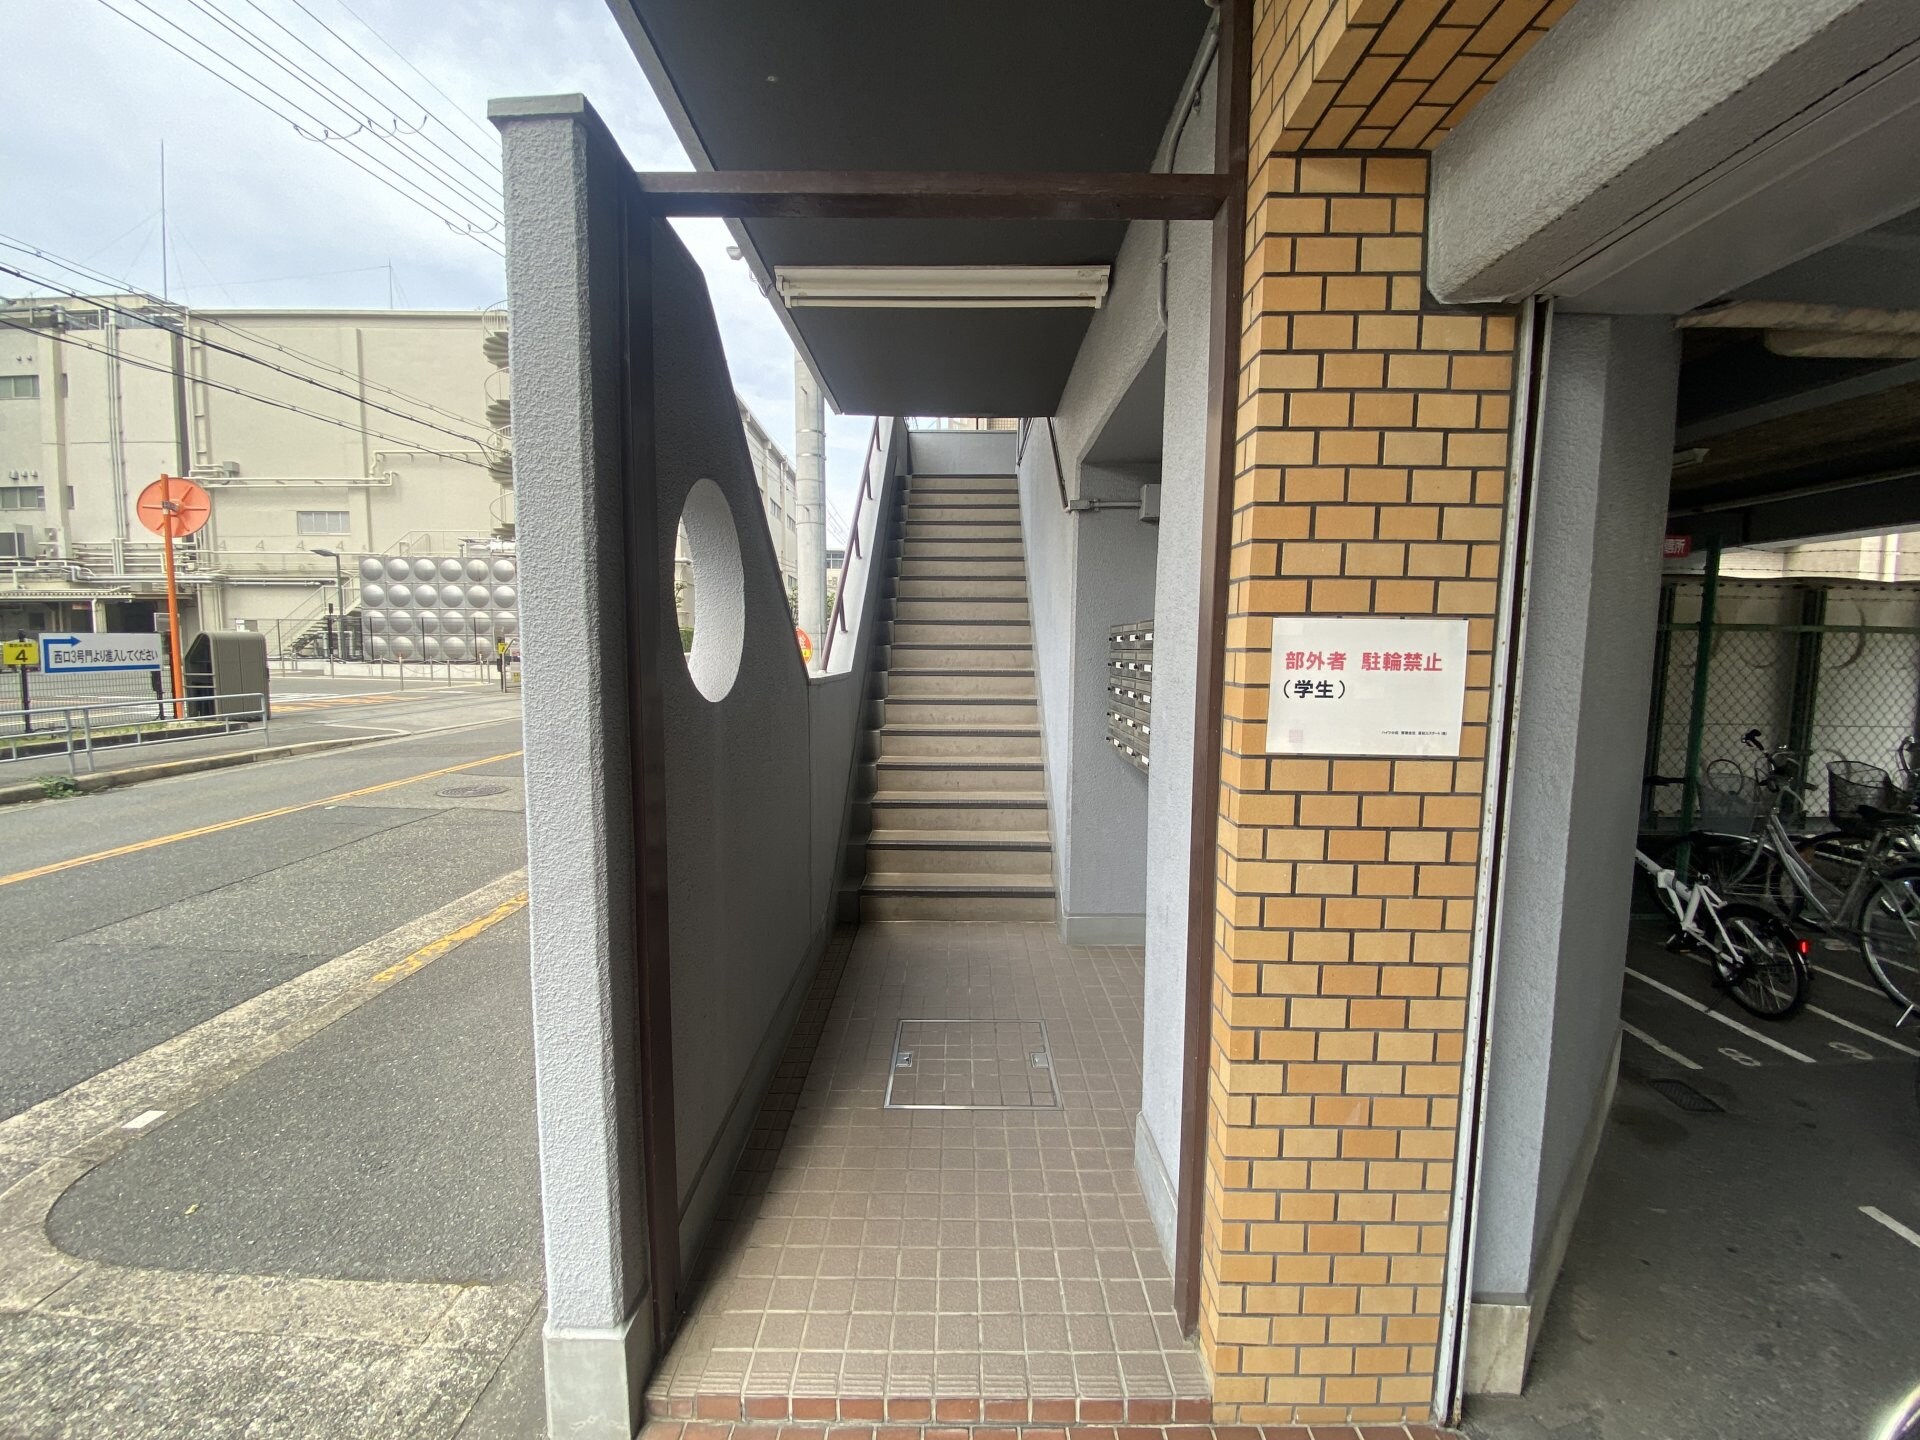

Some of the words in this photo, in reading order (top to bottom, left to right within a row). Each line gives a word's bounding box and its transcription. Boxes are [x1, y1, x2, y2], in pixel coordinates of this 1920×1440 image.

[15, 649, 29, 663] 4
[53, 649, 159, 664] 西口3号門より進入してください
[1285, 650, 1347, 671] 部外者
[1361, 651, 1443, 672] 駐輪禁止
[1282, 679, 1346, 699] （学生）
